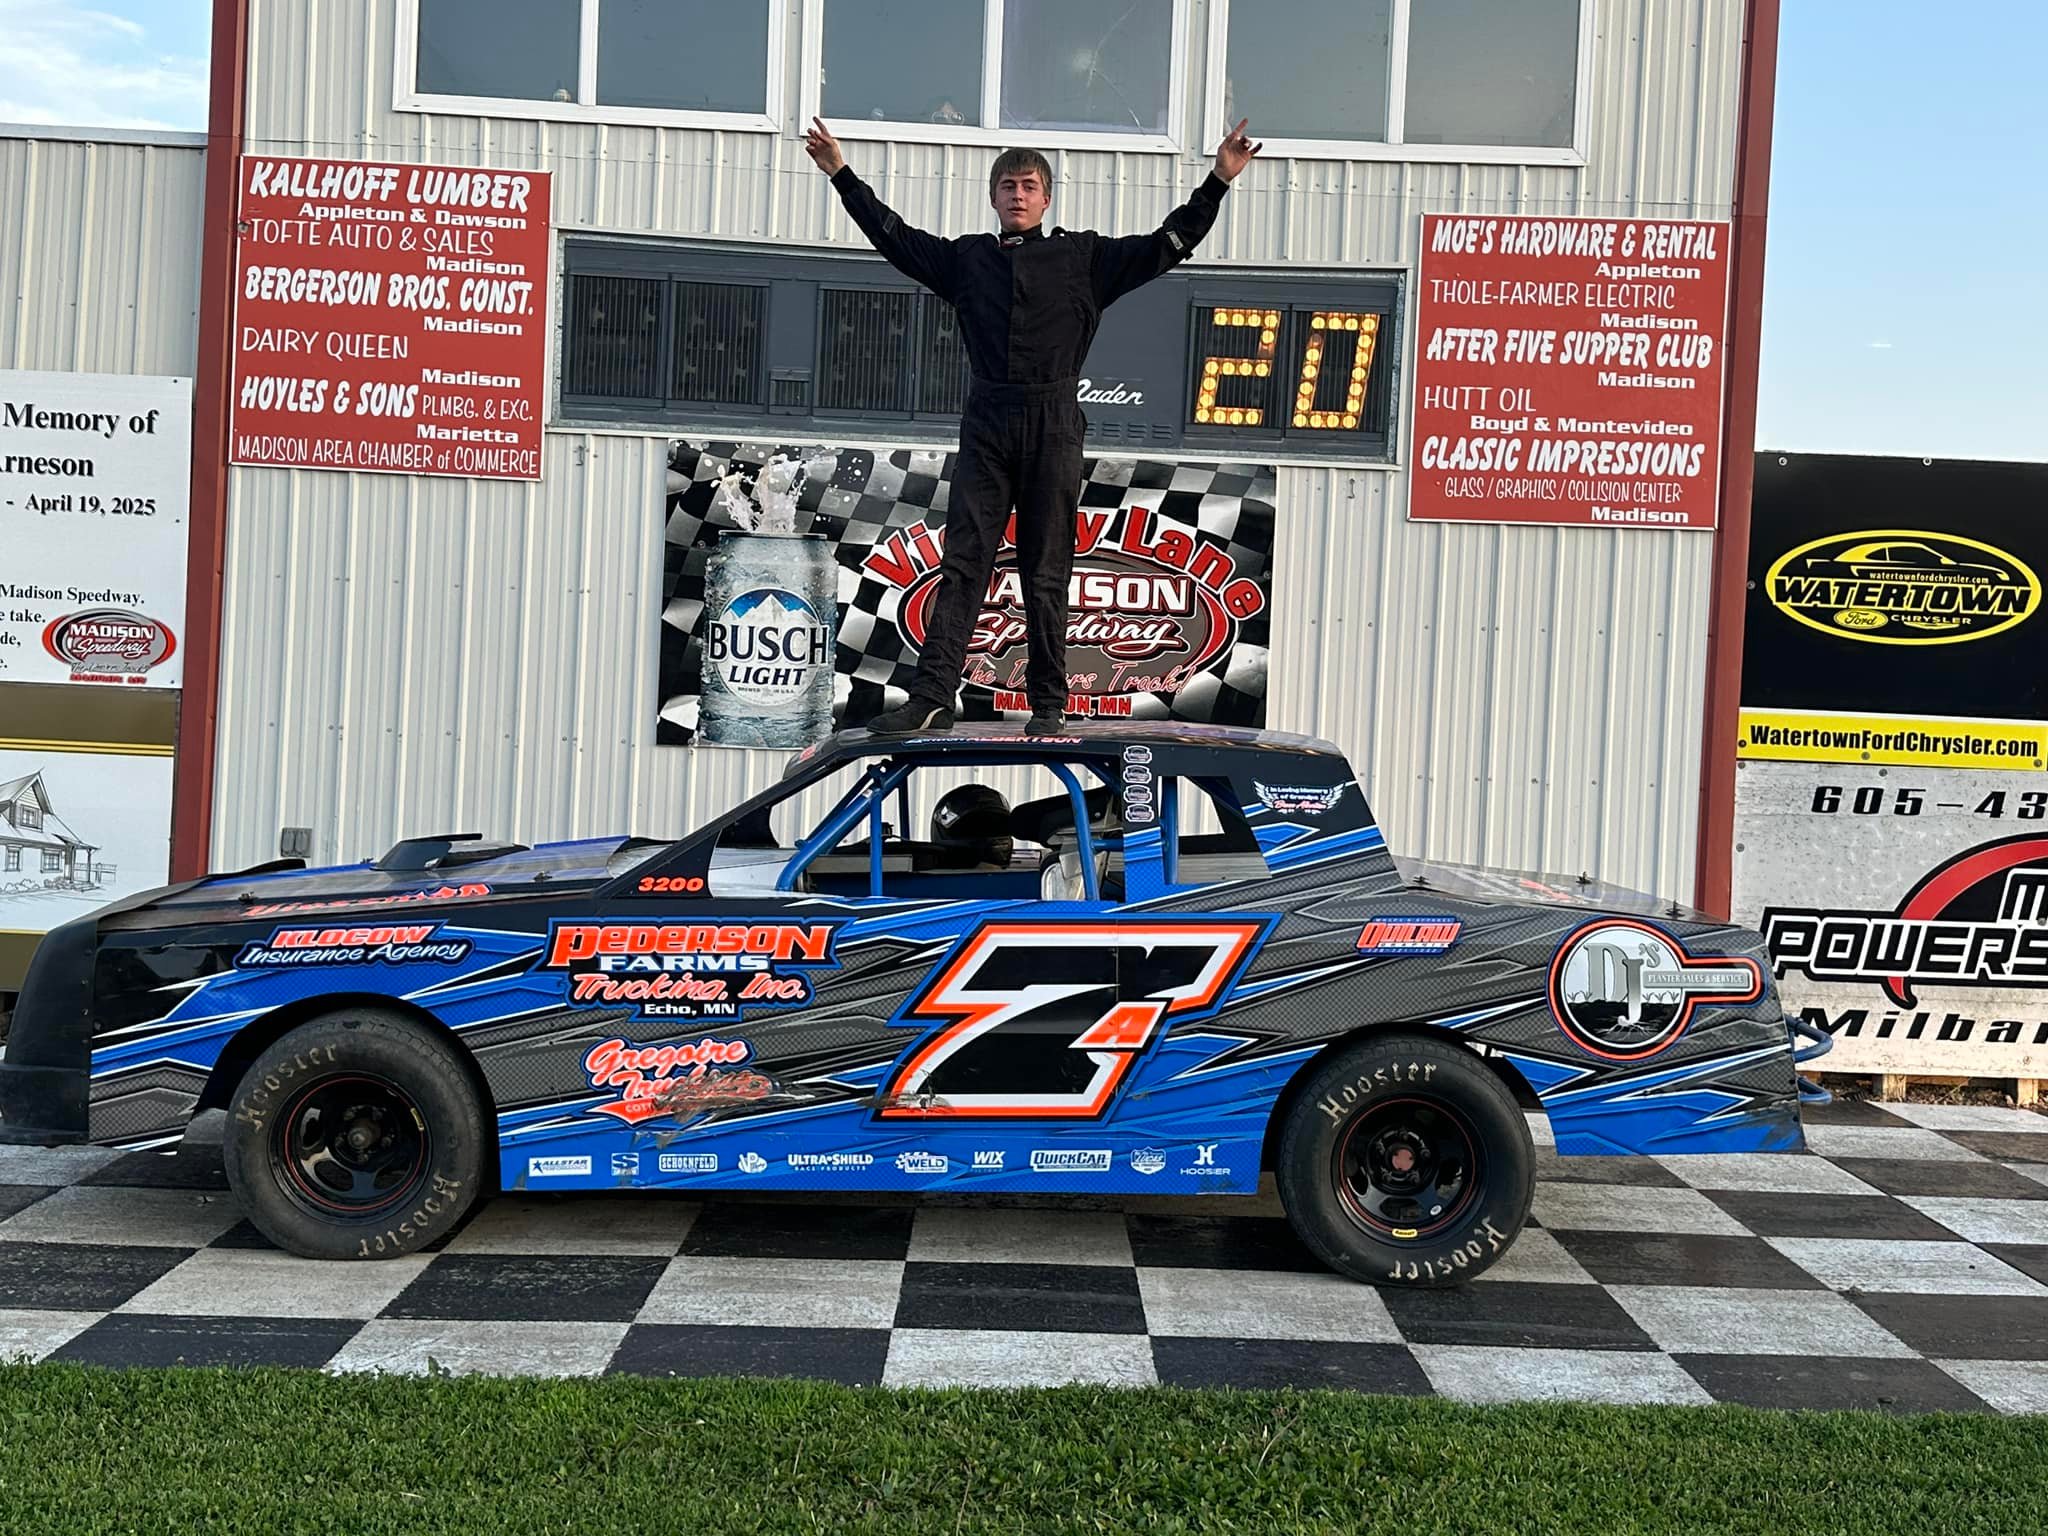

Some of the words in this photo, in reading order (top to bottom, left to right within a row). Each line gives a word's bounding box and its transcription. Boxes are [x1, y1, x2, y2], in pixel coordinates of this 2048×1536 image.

[250, 161, 399, 201] KALLHOFF
[407, 170, 530, 213] LUMBER
[298, 202, 404, 223] Appleton
[410, 209, 427, 224] &
[435, 210, 526, 230] Dawson
[251, 218, 321, 246] TOFTE
[328, 222, 392, 250] AUTO
[399, 228, 417, 251] &
[422, 228, 494, 256] SALES
[1432, 219, 1497, 255] MOE'S
[1500, 220, 1617, 259] HARDWARE
[1621, 224, 1636, 257] &
[1642, 226, 1716, 260] RENTAL
[426, 255, 525, 276] Madison
[1595, 262, 1701, 280] Appleton
[245, 266, 381, 306] BERGERSON
[387, 273, 451, 312] BROS.
[460, 278, 533, 315] CONST.
[1431, 279, 1579, 307] THOLE-FARMER
[1585, 284, 1675, 309] ELECTRIC
[423, 316, 522, 336] Madison
[1600, 313, 1698, 330] Madison
[242, 327, 319, 354] DAIRY
[326, 331, 408, 361] QUEEN
[1427, 327, 1498, 365] AFTER
[1504, 329, 1556, 364] FIVE
[1560, 330, 1650, 369] SUPPER
[1656, 333, 1713, 368] CLUB
[422, 369, 521, 388] Madison
[1194, 308, 1380, 429] 20
[1597, 372, 1696, 389] Madison
[241, 376, 328, 413] HOYLES
[333, 381, 350, 414] &
[356, 382, 419, 418] SONS
[422, 394, 479, 419] PLMBG.
[483, 398, 496, 420] &
[500, 398, 533, 421] EXC.
[1424, 386, 1492, 410] HUTT
[1499, 388, 1536, 412] OIL
[2, 402, 120, 439] Memory
[129, 409, 160, 435] of
[1470, 415, 1528, 434] Boyd
[1534, 417, 1550, 432] &
[1558, 418, 1693, 435] Montevideo
[417, 424, 518, 444] Marietta
[238, 435, 308, 463] MADISON
[312, 439, 354, 465] AREA
[358, 441, 432, 469] CHAMBER
[437, 447, 450, 470] of
[454, 447, 537, 474] COMMERCE
[1422, 436, 1521, 471] CLASSIC
[1527, 440, 1704, 477] IMPRESSIONS
[1445, 477, 1484, 499] GLASS
[1487, 478, 1494, 498] /
[1495, 479, 1556, 500] GRAPHICS
[1559, 481, 1566, 500] /
[1568, 481, 1629, 502] COLLISION
[1633, 483, 1681, 503] CENTER
[24, 493, 72, 516] April
[79, 495, 106, 515] 19,
[111, 497, 156, 516] 2025
[1591, 506, 1689, 523] Madison
[1120, 505, 1262, 617] Lane
[1869, 571, 1989, 585] watertownfordchrysler.com
[0, 583, 63, 600] Madison
[67, 587, 145, 605] Speedway.
[1773, 576, 2033, 616] WATERTOWN
[10, 610, 46, 623] take.
[1843, 611, 1877, 627] Ford
[1891, 614, 1971, 625] CHRYSLER
[70, 623, 153, 639] MADISON
[709, 621, 829, 664] BUSCH
[73, 637, 149, 662] Speedway
[728, 665, 806, 686] LIGHT
[1097, 696, 1132, 715] MN
[1750, 724, 2039, 757] WatertownFordChrysler.com
[638, 877, 704, 892] 3200
[272, 925, 435, 949] KLOCOW
[240, 947, 362, 965] Insurance
[367, 942, 467, 960] Agency
[599, 955, 770, 971] FARMS
[574, 973, 728, 1001] Trucking,
[738, 973, 806, 1000] Inc.
[1682, 975, 1704, 983] SALES
[1714, 975, 1743, 983] SERVICE
[644, 1003, 697, 1016] Echo,
[703, 1003, 735, 1015] MN
[586, 1038, 748, 1086] Gregoire
[1316, 1062, 1437, 1128] Hoosier
[907, 1158, 945, 1168] WELD
[974, 1151, 1006, 1165] WIX
[1179, 1167, 1231, 1176] HOOSIER
[1388, 1216, 1508, 1280] Hoosier
